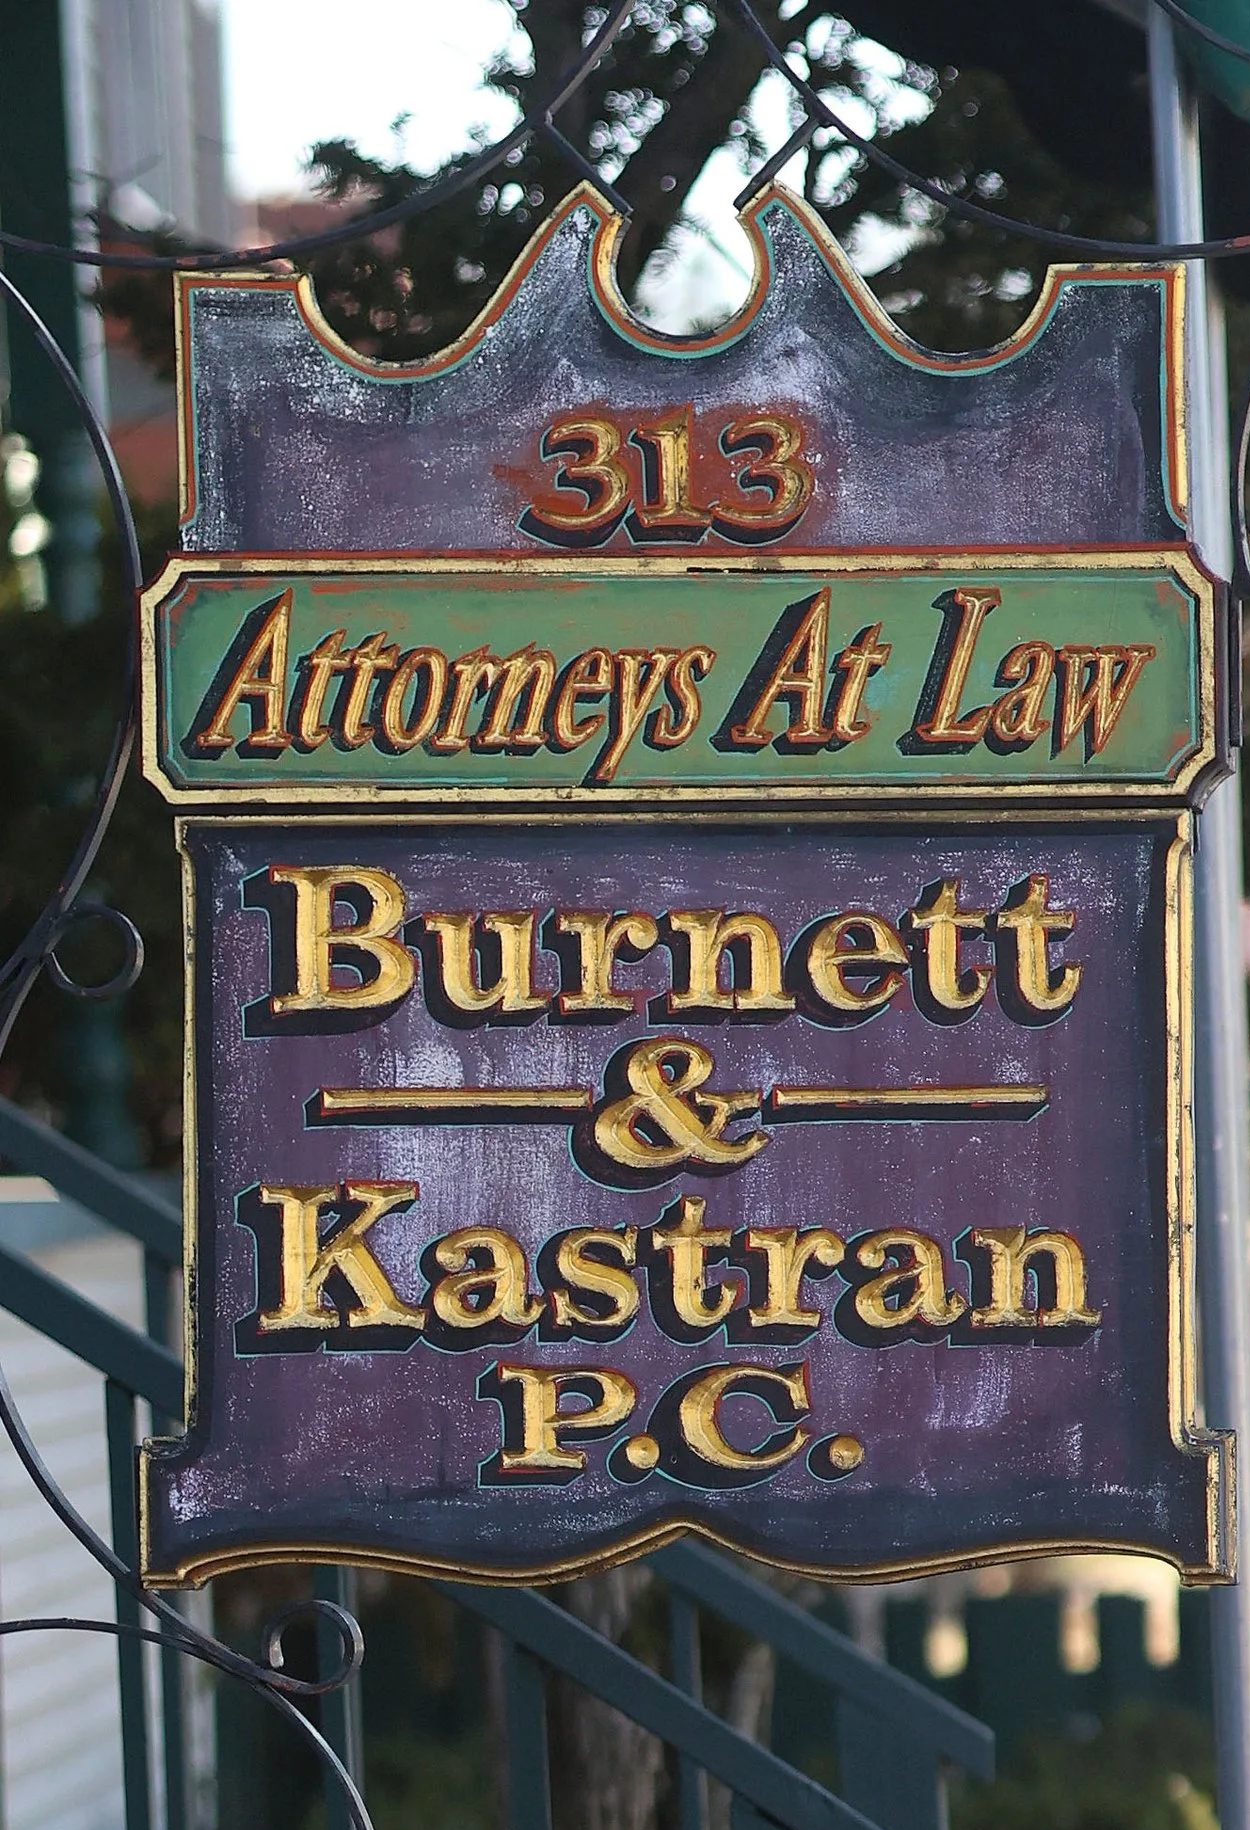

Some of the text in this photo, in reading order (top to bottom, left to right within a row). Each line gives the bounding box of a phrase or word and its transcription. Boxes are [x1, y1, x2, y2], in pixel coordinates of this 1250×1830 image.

[537, 415, 812, 530] 313
[197, 586, 1155, 781] Attorneys At Law
[270, 865, 1082, 1015] Burnett
[593, 1036, 768, 1169] &
[259, 1182, 1102, 1333] Kastran
[497, 1363, 865, 1472] P.C.
